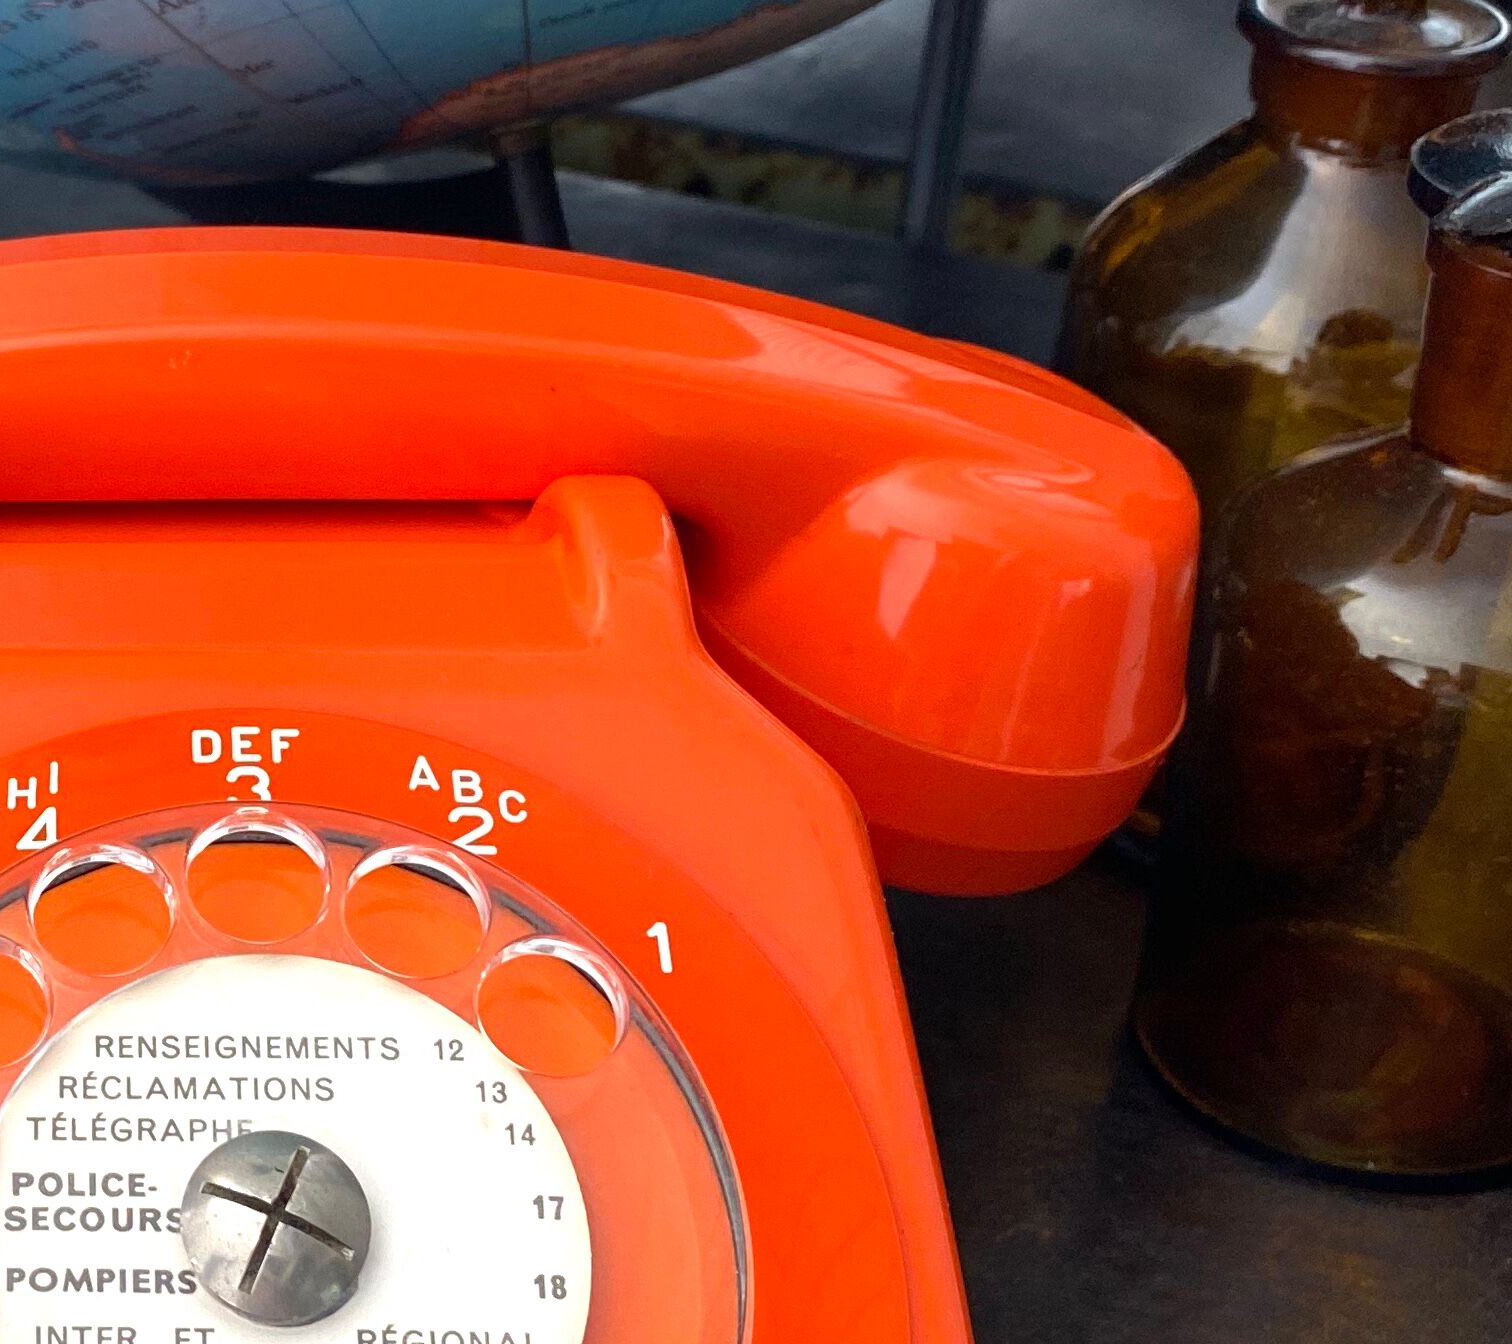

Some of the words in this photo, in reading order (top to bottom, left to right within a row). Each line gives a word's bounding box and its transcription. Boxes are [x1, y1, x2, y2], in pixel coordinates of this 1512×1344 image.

[647, 920, 674, 974] 1
[94, 1033, 401, 1062] RENSEIGNEMENTS
[433, 1038, 465, 1062] 12
[57, 1069, 336, 1102] RÉCLAMATIONS
[475, 1080, 507, 1104] 13
[504, 1123, 536, 1147] 14
[11, 1173, 158, 1199] POLICE-
[532, 1196, 565, 1221] 17
[5, 1268, 197, 1296] POMPIERS
[533, 1274, 568, 1300] 18
